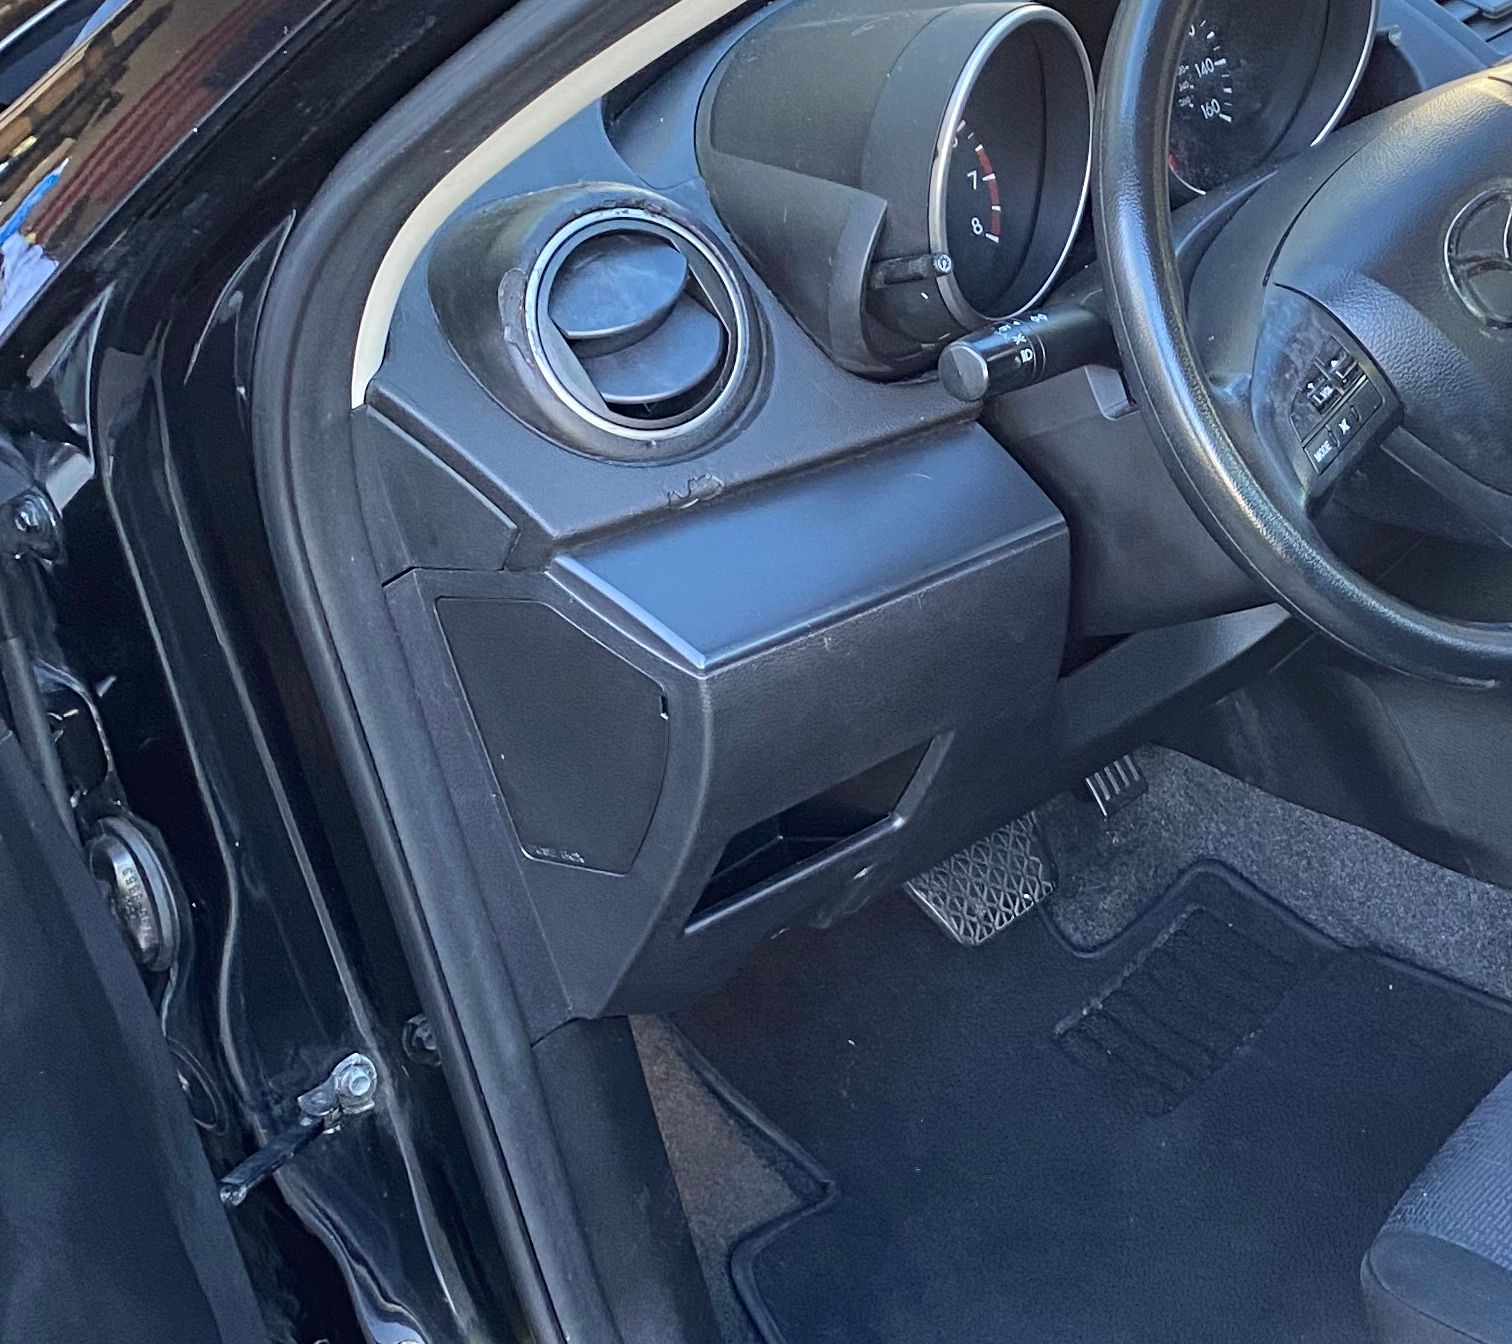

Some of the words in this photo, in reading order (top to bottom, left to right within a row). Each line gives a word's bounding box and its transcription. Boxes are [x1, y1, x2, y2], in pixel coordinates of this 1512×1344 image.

[1194, 57, 1215, 78] 140
[1201, 98, 1221, 119] 160
[967, 169, 978, 191] 7
[971, 216, 983, 235] 8
[1313, 440, 1333, 463] MODE
